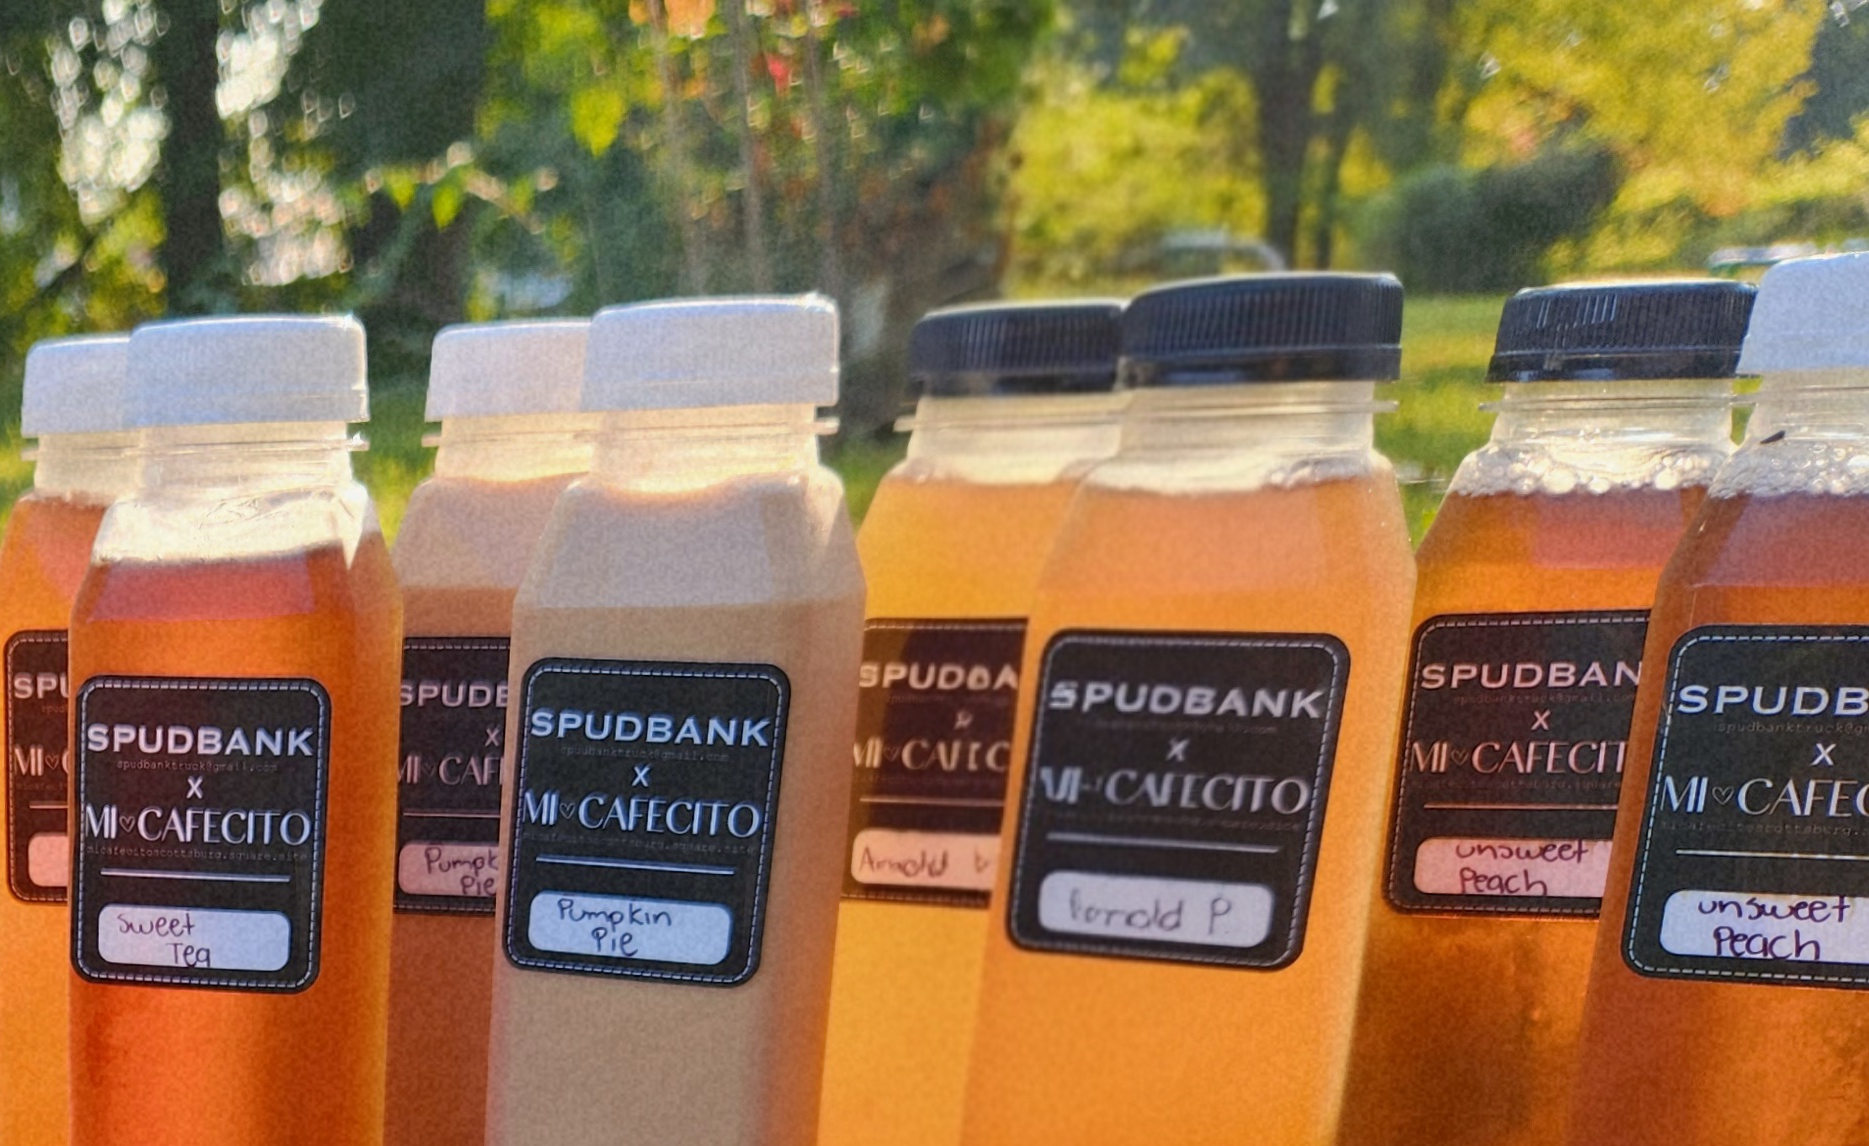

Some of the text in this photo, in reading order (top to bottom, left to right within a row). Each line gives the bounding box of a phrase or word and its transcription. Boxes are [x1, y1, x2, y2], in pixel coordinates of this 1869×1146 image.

[1049, 680, 1326, 719] SPUDBANK
[86, 722, 315, 757] SPUDBANK
[531, 707, 772, 747] SPUDBANK
[13, 743, 44, 777] MI
[439, 755, 503, 786] CAF
[1409, 740, 1449, 773] MI
[1660, 774, 1709, 813] MI
[85, 802, 312, 846] MI CAFECITO
[522, 788, 763, 838] MI CAFECITO
[1460, 868, 1547, 896] Peach
[557, 897, 673, 927] Pumpkin
[166, 941, 211, 969] Tea
[592, 929, 638, 957] Pie
[1713, 927, 1821, 960] Peach
